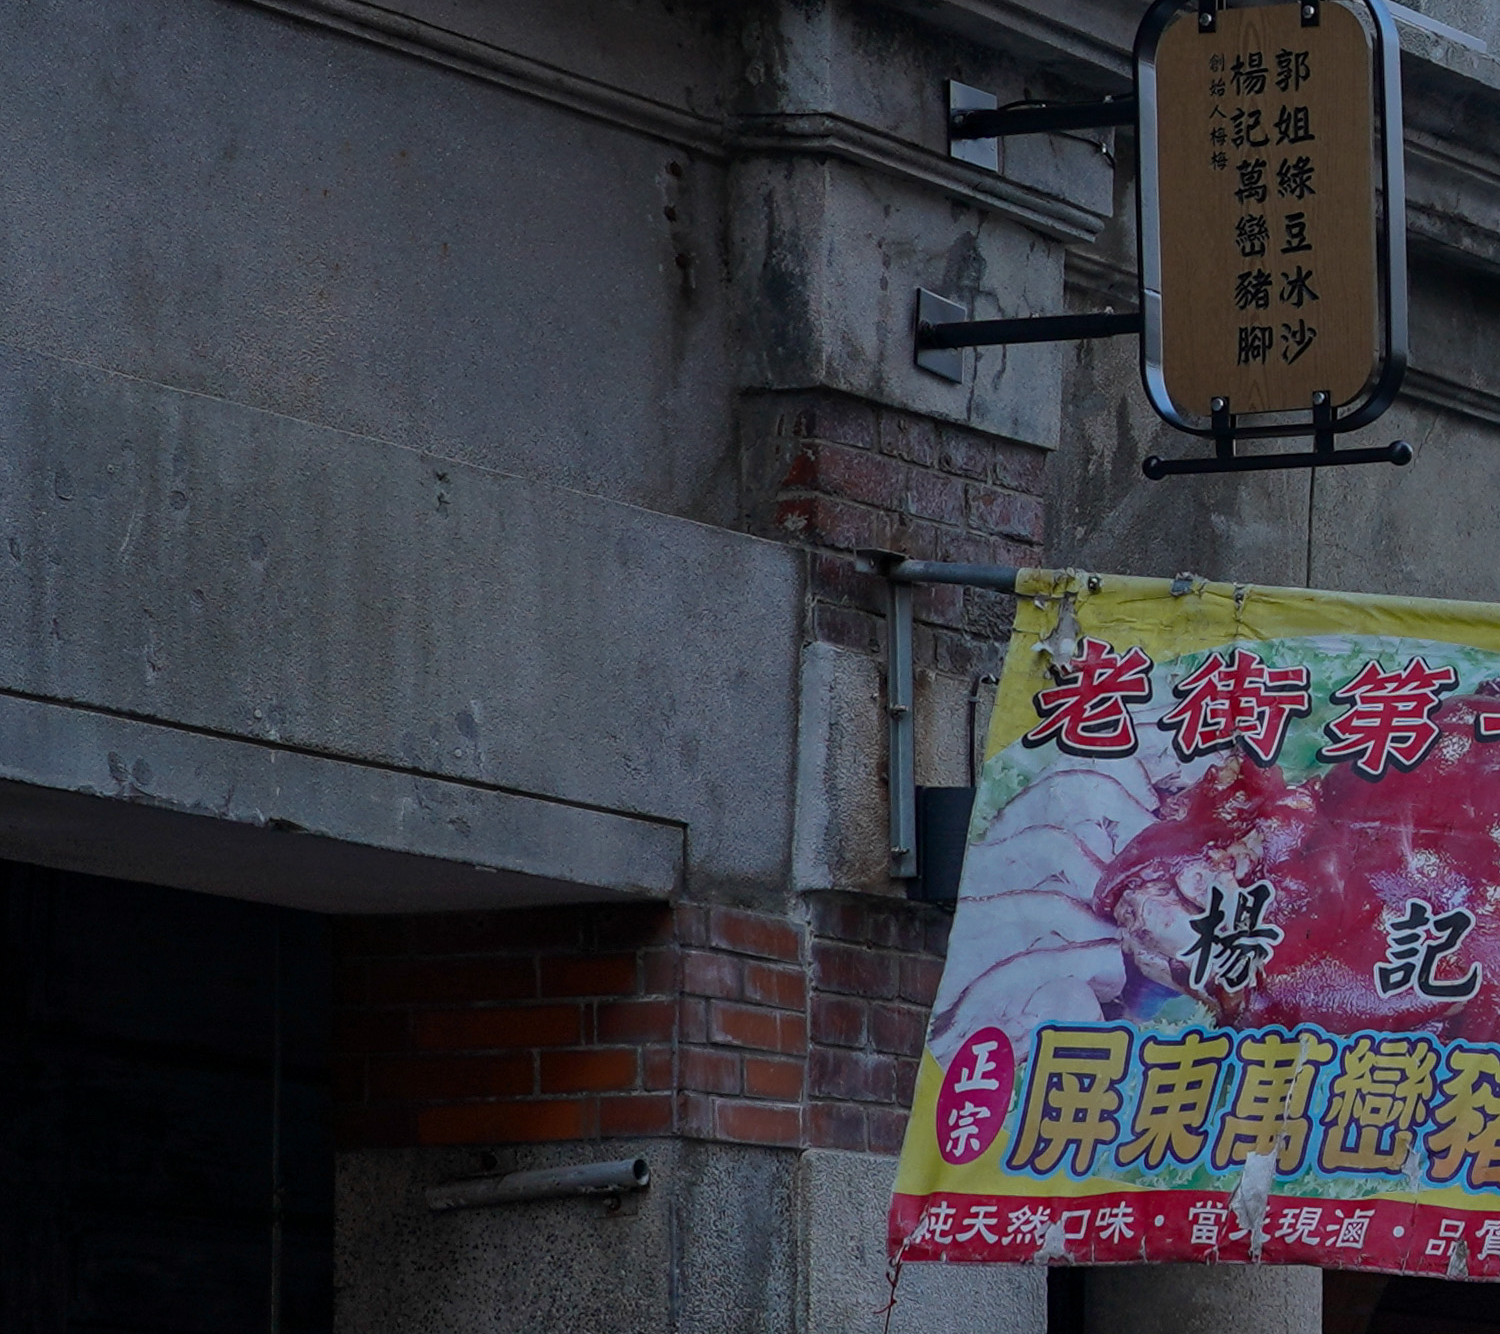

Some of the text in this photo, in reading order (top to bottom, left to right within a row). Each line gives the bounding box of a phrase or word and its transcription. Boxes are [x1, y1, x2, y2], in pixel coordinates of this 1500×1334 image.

[1229, 50, 1275, 367] 楊記萬巒豬腳
[1273, 47, 1320, 367] 郭姐綠豆冰沙
[1180, 883, 1484, 1001] 楊記
[943, 1038, 1003, 1158] 正宗
